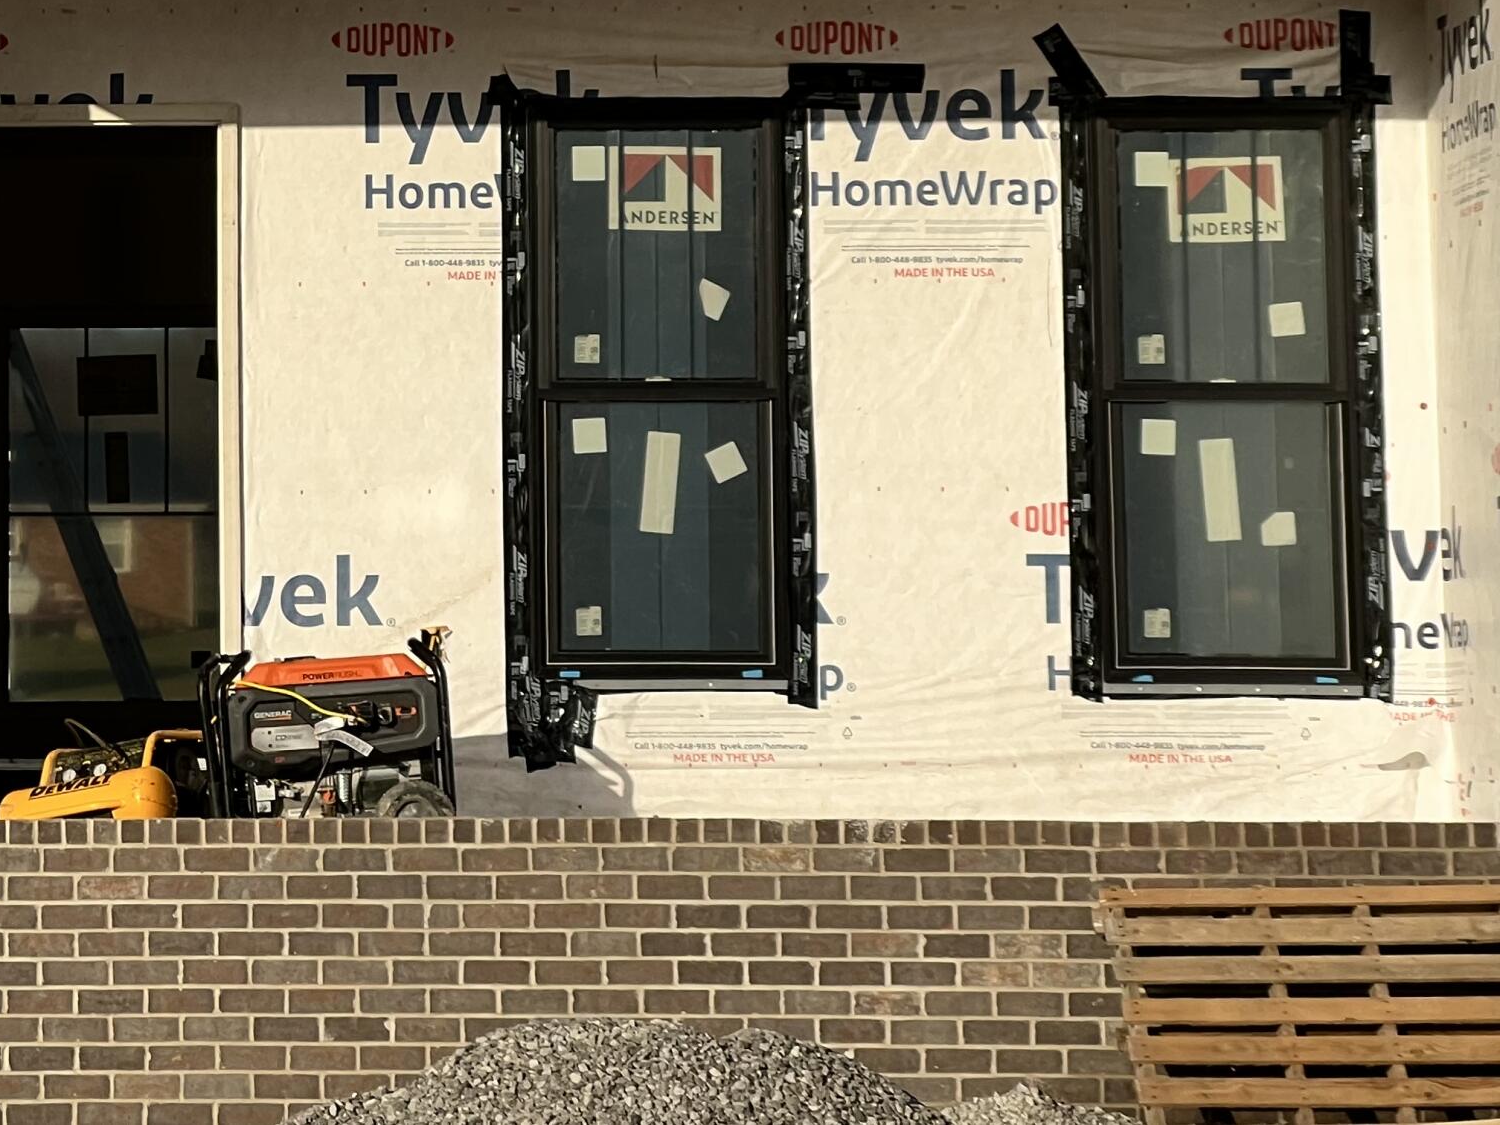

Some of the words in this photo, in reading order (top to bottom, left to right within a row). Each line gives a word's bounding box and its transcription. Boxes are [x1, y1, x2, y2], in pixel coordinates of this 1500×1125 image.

[347, 23, 441, 57] DUPONT
[791, 21, 885, 54] DUPONT
[1239, 18, 1337, 52] DUPONT
[365, 174, 502, 209] Home
[810, 170, 1058, 215] HomeWrap
[1181, 220, 1279, 236] NDERSEN
[447, 271, 481, 280] MADE
[484, 271, 496, 280] IN
[894, 267, 929, 277] MADE
[931, 267, 943, 277] IN
[947, 267, 969, 277] THE
[972, 267, 995, 277] USA
[1025, 502, 1070, 537] DUP
[1390, 505, 1466, 582] vek
[245, 555, 382, 628] vek
[254, 710, 292, 719] GENERAC
[1390, 711, 1417, 722] ADE
[674, 753, 707, 763] MADE
[711, 753, 723, 763] IN
[727, 753, 748, 763] THE
[752, 753, 775, 763] USA
[1128, 753, 1164, 763] MADE
[1168, 753, 1180, 763] IN
[1183, 753, 1205, 763] THE
[1209, 753, 1233, 763] USA
[30, 775, 111, 798] DEWALT
